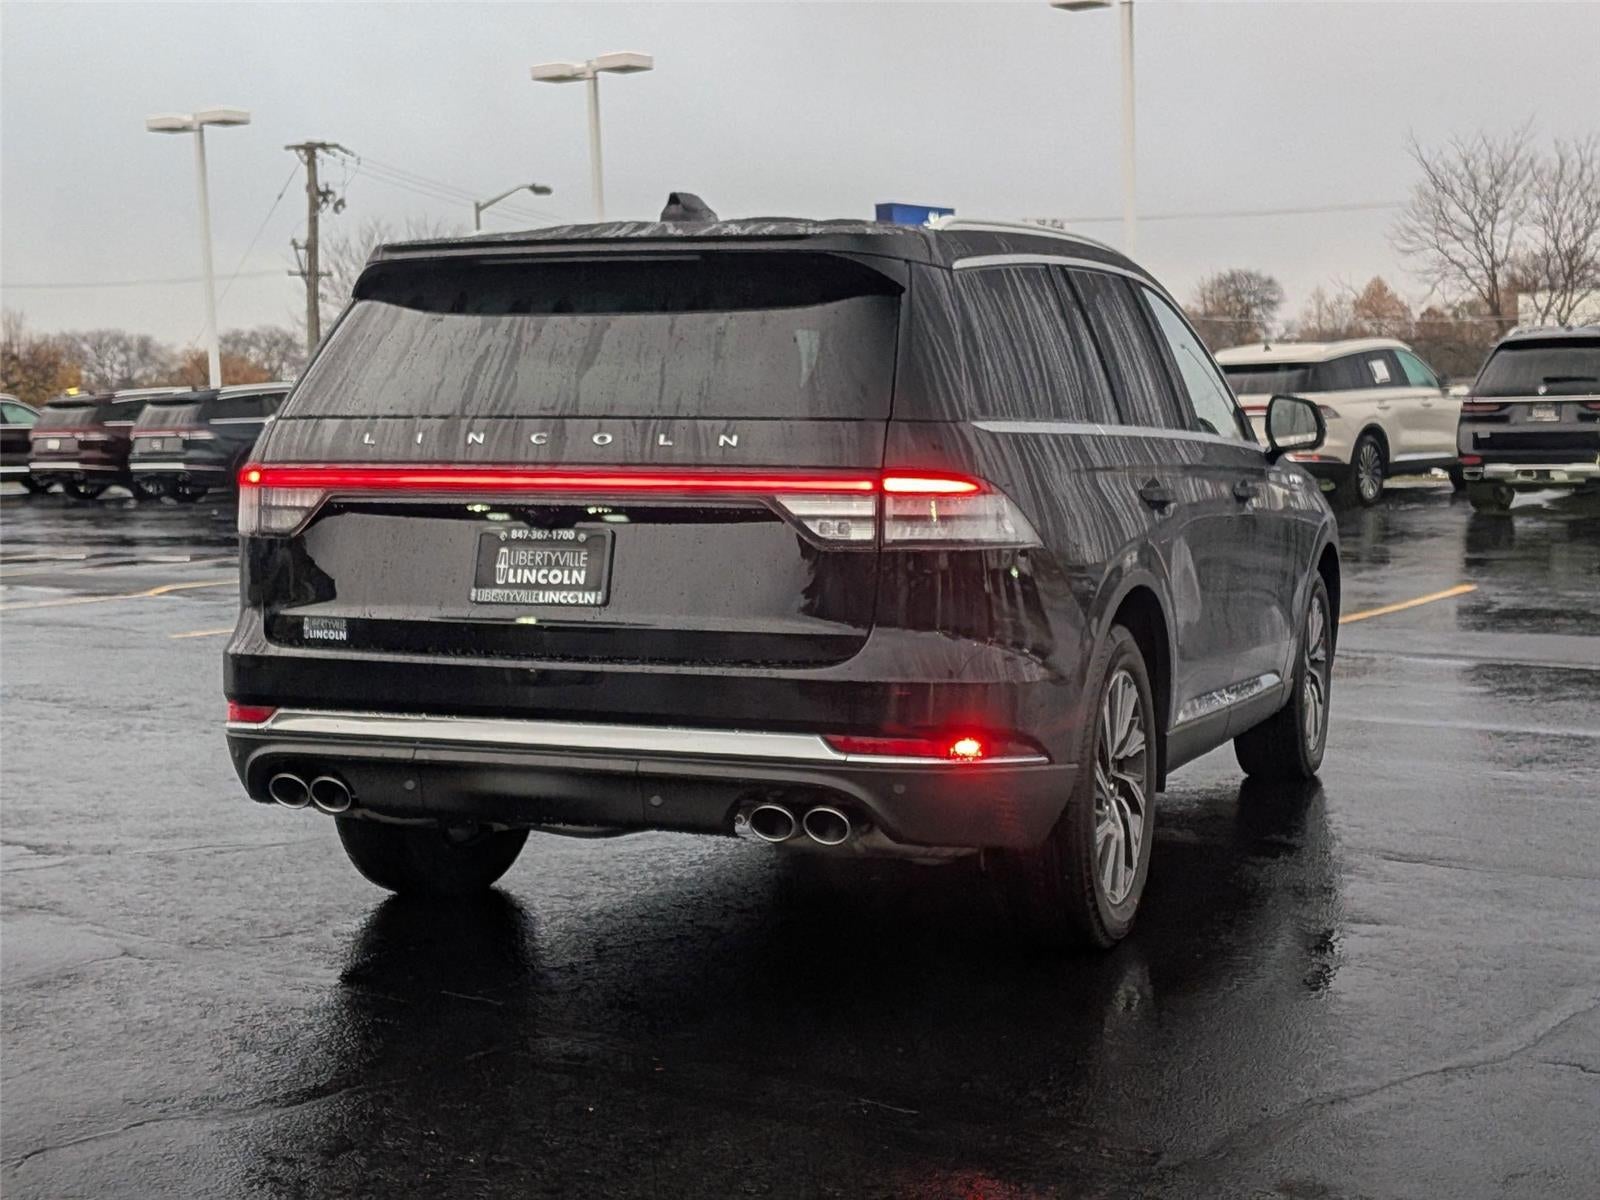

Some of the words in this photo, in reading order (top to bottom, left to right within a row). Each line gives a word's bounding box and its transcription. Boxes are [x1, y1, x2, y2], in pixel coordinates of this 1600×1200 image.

[363, 431, 739, 448] LINCOLN
[511, 529, 576, 541] 847-367-1700
[509, 551, 589, 567] LIBERTYVILLE
[508, 568, 587, 585] LINCOLN
[310, 629, 347, 641] LINCOLN
